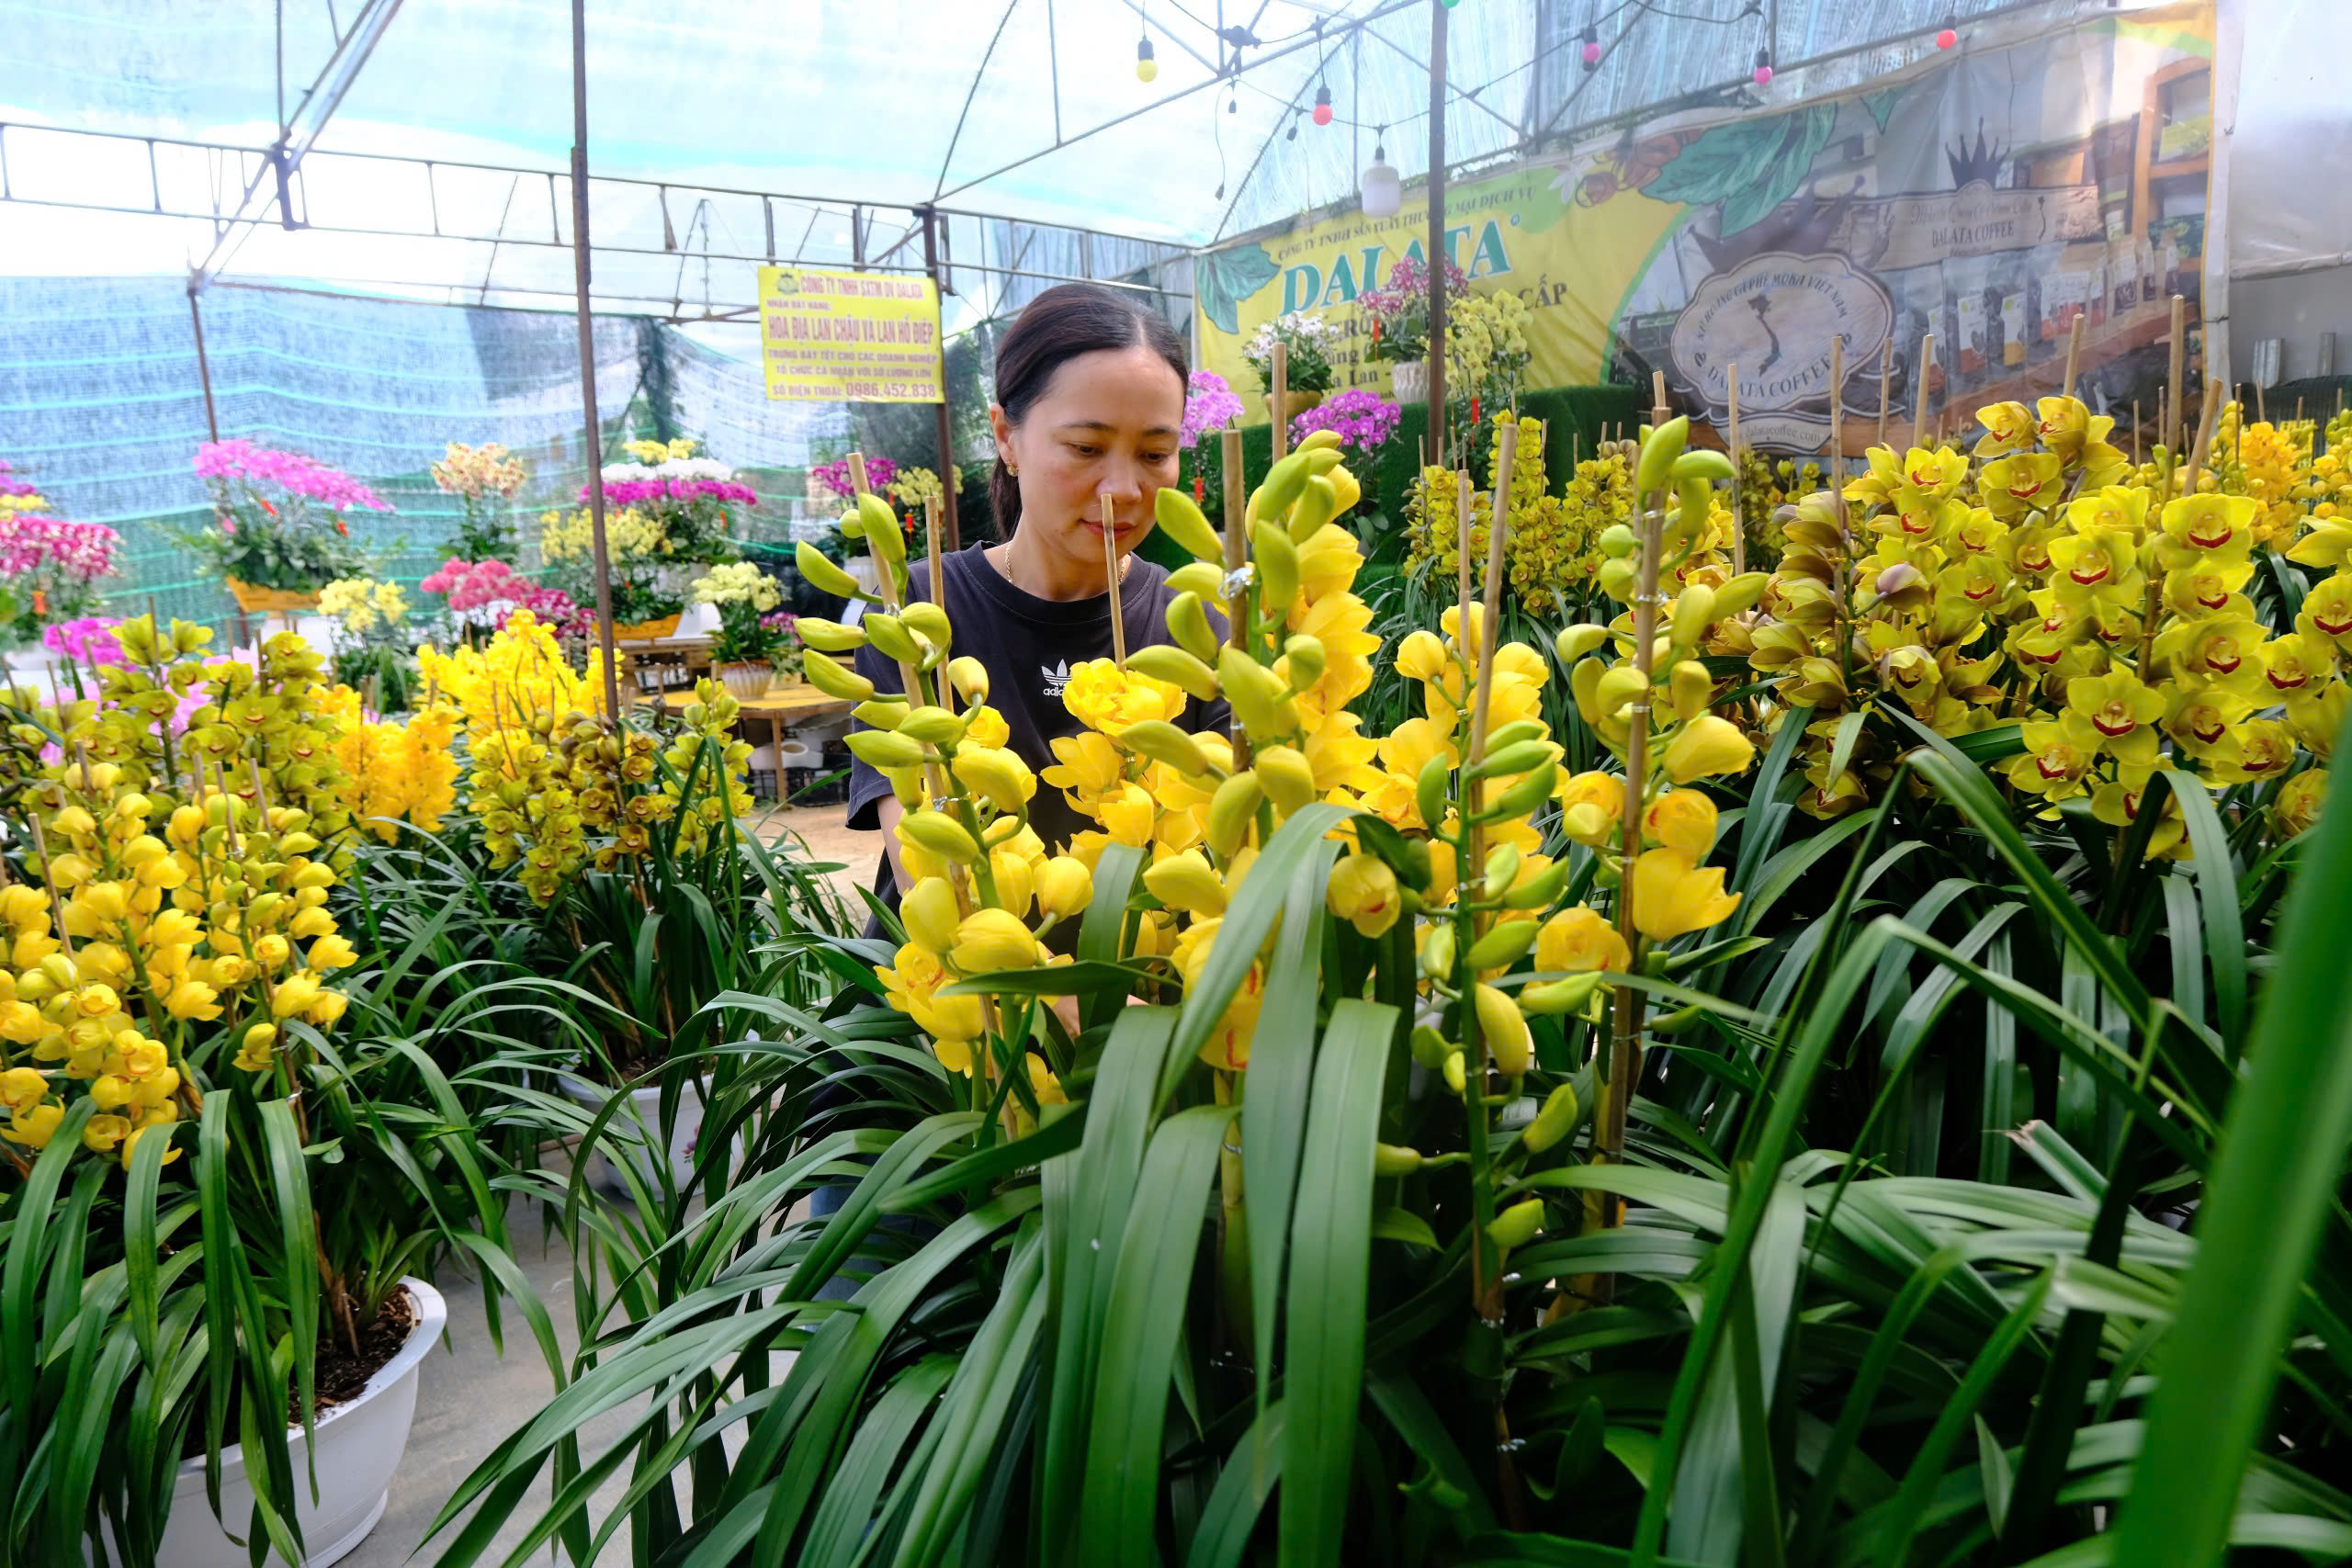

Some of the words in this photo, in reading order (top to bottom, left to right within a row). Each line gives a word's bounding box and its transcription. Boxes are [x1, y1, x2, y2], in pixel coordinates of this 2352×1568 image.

[801, 273, 824, 293] CÔNG
[826, 276, 836, 294] TY
[1517, 273, 1567, 310] CẤP
[768, 316, 789, 339] HOA
[811, 317, 831, 341] LAN
[877, 320, 896, 344] LAN
[846, 381, 935, 399] 0986.452.838
[1708, 366, 1764, 398] DAATA
